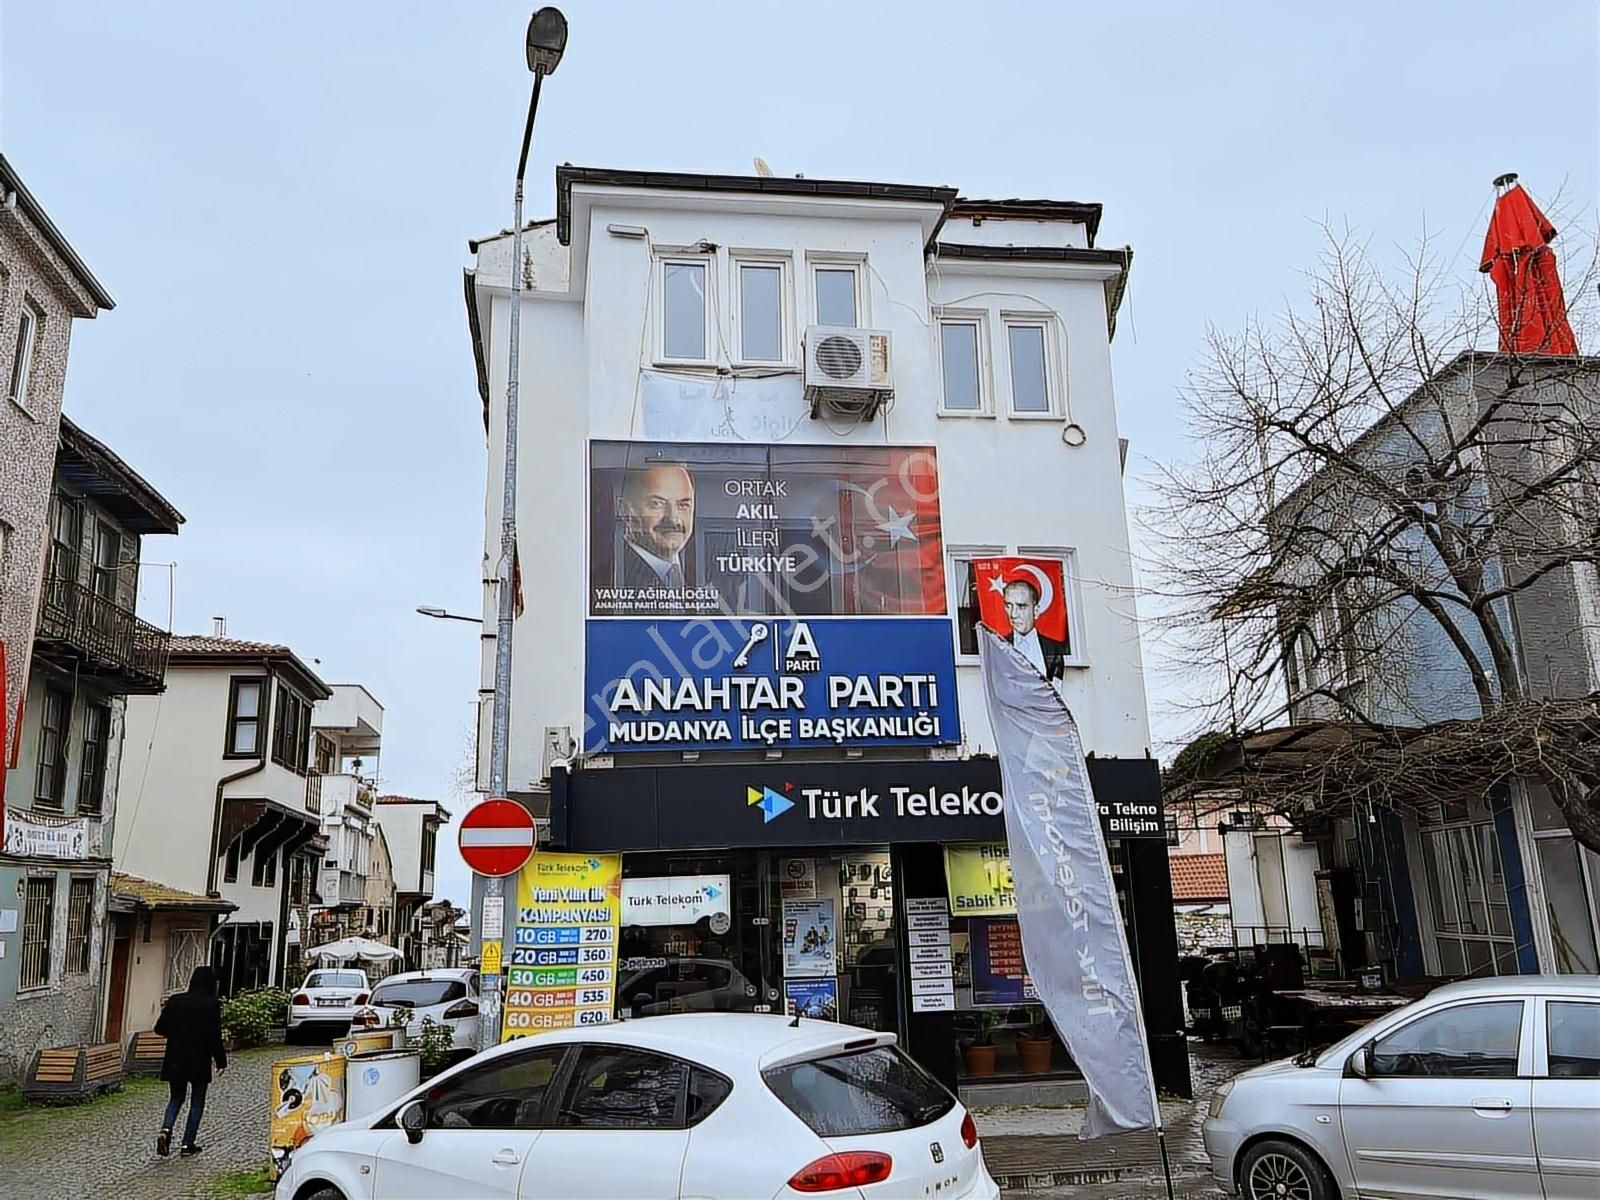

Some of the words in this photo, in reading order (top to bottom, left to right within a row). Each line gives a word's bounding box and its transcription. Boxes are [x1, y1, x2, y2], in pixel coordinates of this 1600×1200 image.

[725, 480, 788, 496] ORTAK
[736, 504, 779, 520] AKIL
[736, 527, 780, 547] İLERİ
[716, 552, 797, 573] TÜRKİYE
[595, 587, 635, 600] YAVUZ
[595, 601, 633, 609] ANAHTAR
[658, 601, 684, 610] GENEL
[786, 622, 820, 658] A
[609, 676, 805, 712] ANAHTAR
[609, 720, 732, 743] MUDANYA
[742, 714, 791, 745] İLÇE
[799, 711, 941, 743] BAŞKANLIĞI
[802, 787, 880, 819] Türk
[889, 785, 1004, 816] Teleko
[1113, 802, 1157, 815] Tekno
[1110, 818, 1159, 834] Bilişim
[537, 863, 553, 872] Türk
[628, 895, 652, 906] Türk
[656, 893, 703, 905] Telekom
[956, 894, 995, 908] Sabit
[516, 929, 535, 941] 10
[537, 931, 556, 943] GB
[585, 929, 606, 940] 270
[514, 949, 535, 963] 20
[538, 952, 557, 964] GB
[583, 949, 606, 961] 360
[511, 970, 534, 984] 30
[535, 973, 555, 985] GB
[581, 970, 604, 982] 450
[508, 991, 532, 1005] 40
[533, 994, 554, 1006] GB
[582, 990, 604, 1003] 535
[507, 1012, 530, 1026] 60
[531, 1015, 552, 1028] GB
[580, 1011, 602, 1024] 620
